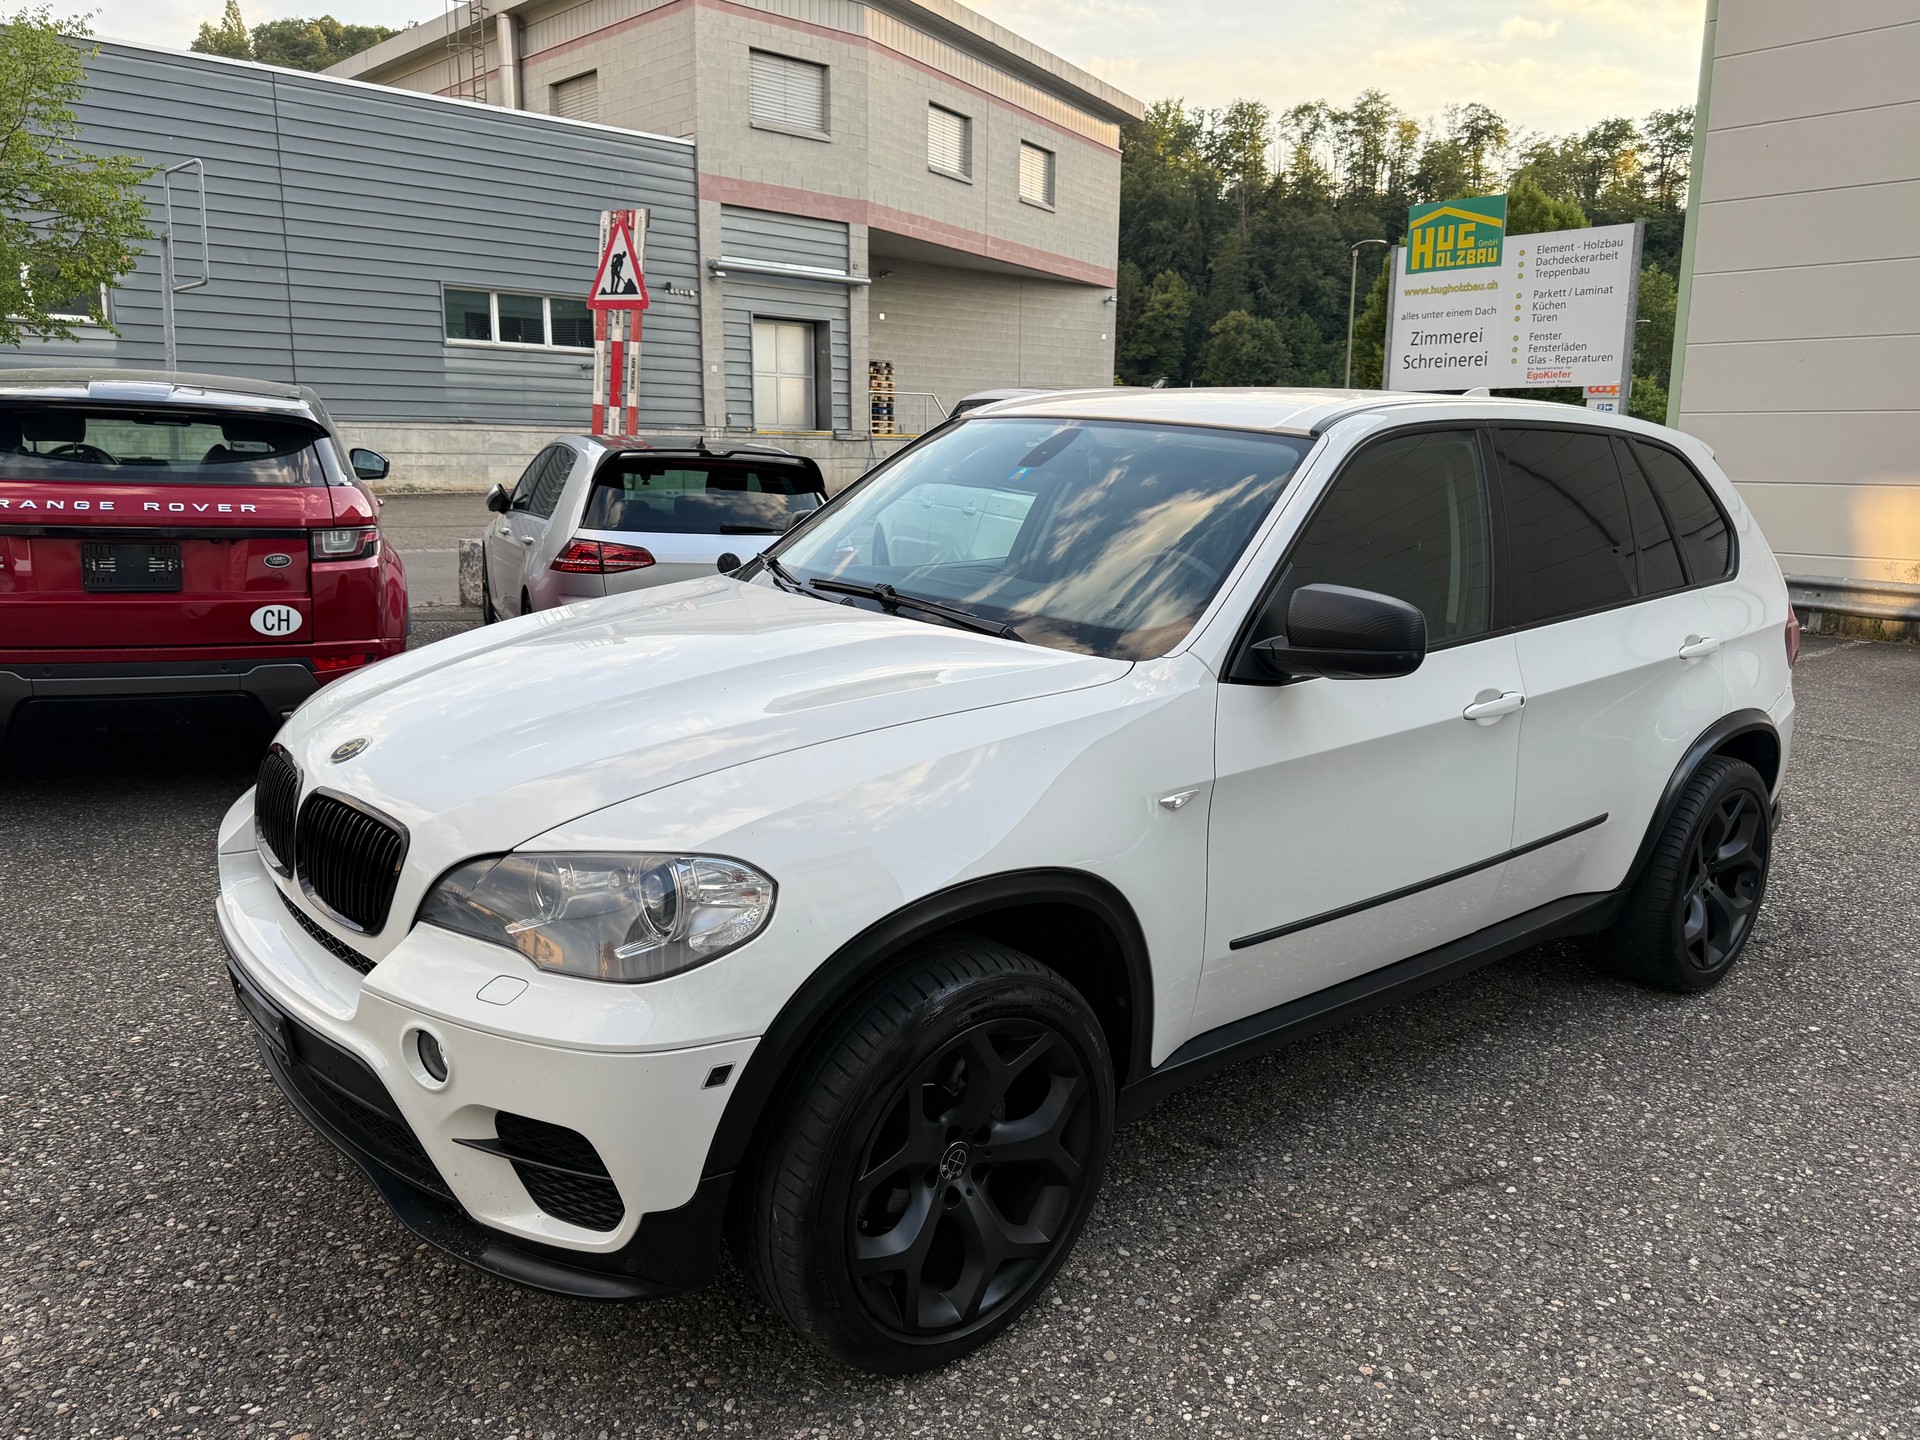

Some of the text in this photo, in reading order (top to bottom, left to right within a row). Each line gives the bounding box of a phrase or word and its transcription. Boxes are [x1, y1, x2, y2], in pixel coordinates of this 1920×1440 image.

[1411, 222, 1498, 270] HUG GmbH
[1537, 243, 1574, 255] Element
[1583, 238, 1624, 250] Holzbau
[1535, 251, 1619, 267] Dachdeckerarbeit
[1535, 266, 1590, 279] Treppenbau
[1404, 280, 1498, 297] www.hugholzbau.ch
[1533, 289, 1566, 299] Parkett
[1574, 285, 1614, 296] Laminat
[1532, 301, 1567, 311] Küchen
[1401, 306, 1497, 321] alles unter einem Dach
[1531, 313, 1558, 323] Türen
[1410, 327, 1484, 346] Zimmerei
[1529, 332, 1563, 341] Fenster
[1528, 342, 1588, 353] Fensterläden
[1403, 350, 1488, 370] Schreinerei
[1527, 355, 1547, 365] Glas
[1554, 353, 1614, 365] Reparaturen
[1526, 370, 1572, 380] EgoKiefer
[143, 502, 257, 513] ROVER
[262, 609, 290, 632] CH
